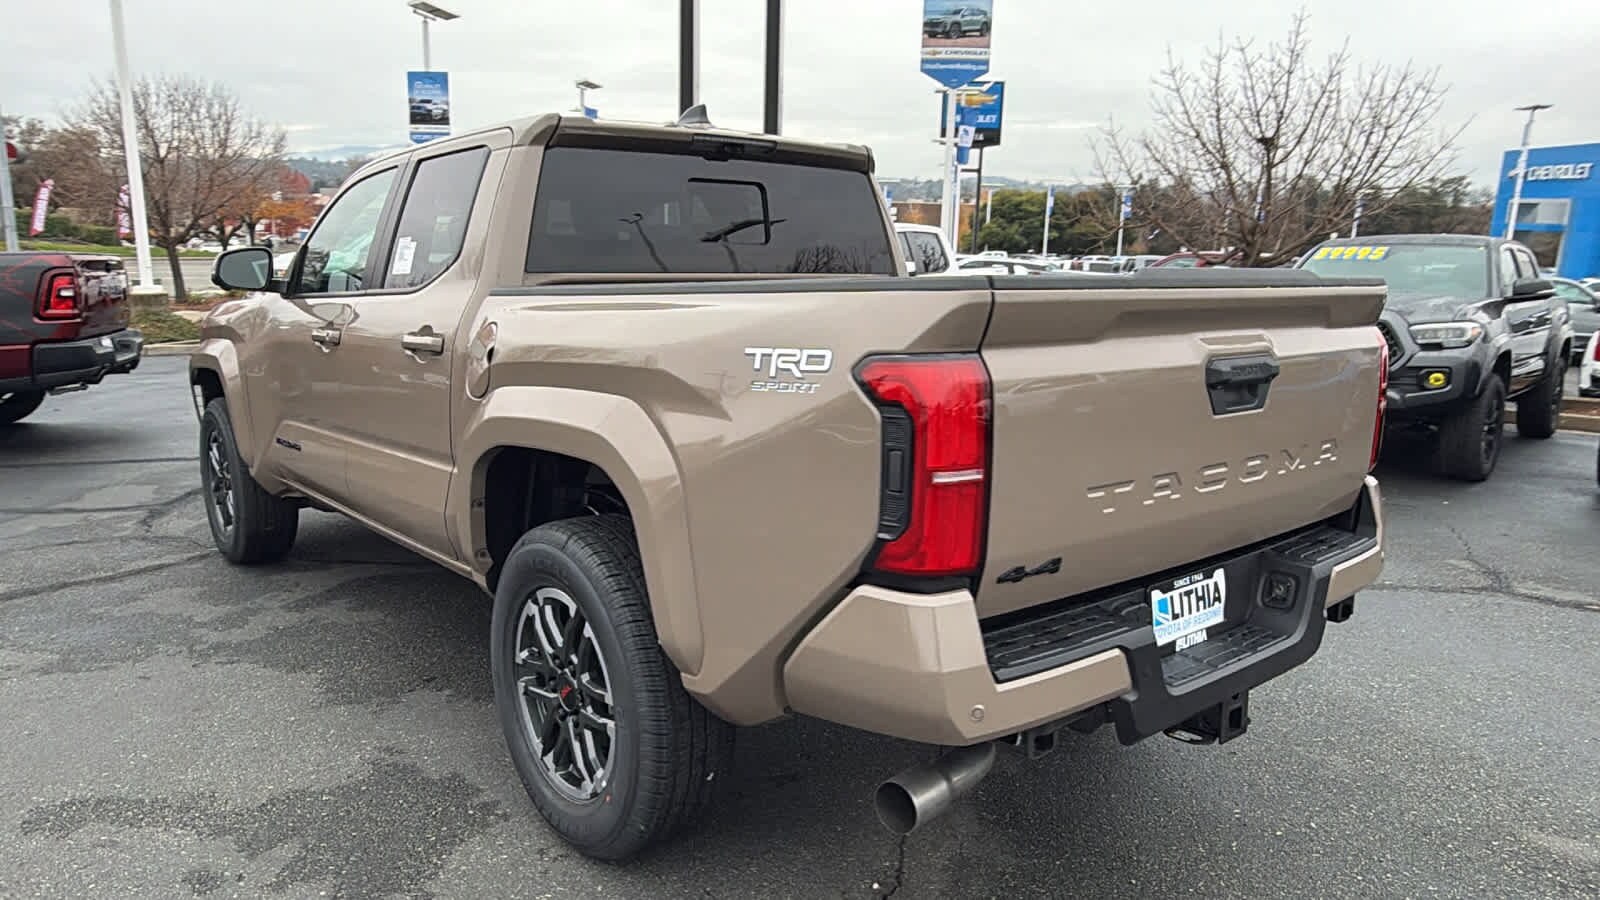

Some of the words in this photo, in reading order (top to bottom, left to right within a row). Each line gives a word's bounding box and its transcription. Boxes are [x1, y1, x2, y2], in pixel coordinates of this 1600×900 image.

[1527, 163, 1594, 181] CHEVROLET
[744, 347, 833, 378] TRD
[751, 381, 821, 394] SPORT
[1087, 438, 1339, 514] TACOMA
[1174, 576, 1190, 589] SINCE
[1170, 581, 1222, 621] LITHIA
